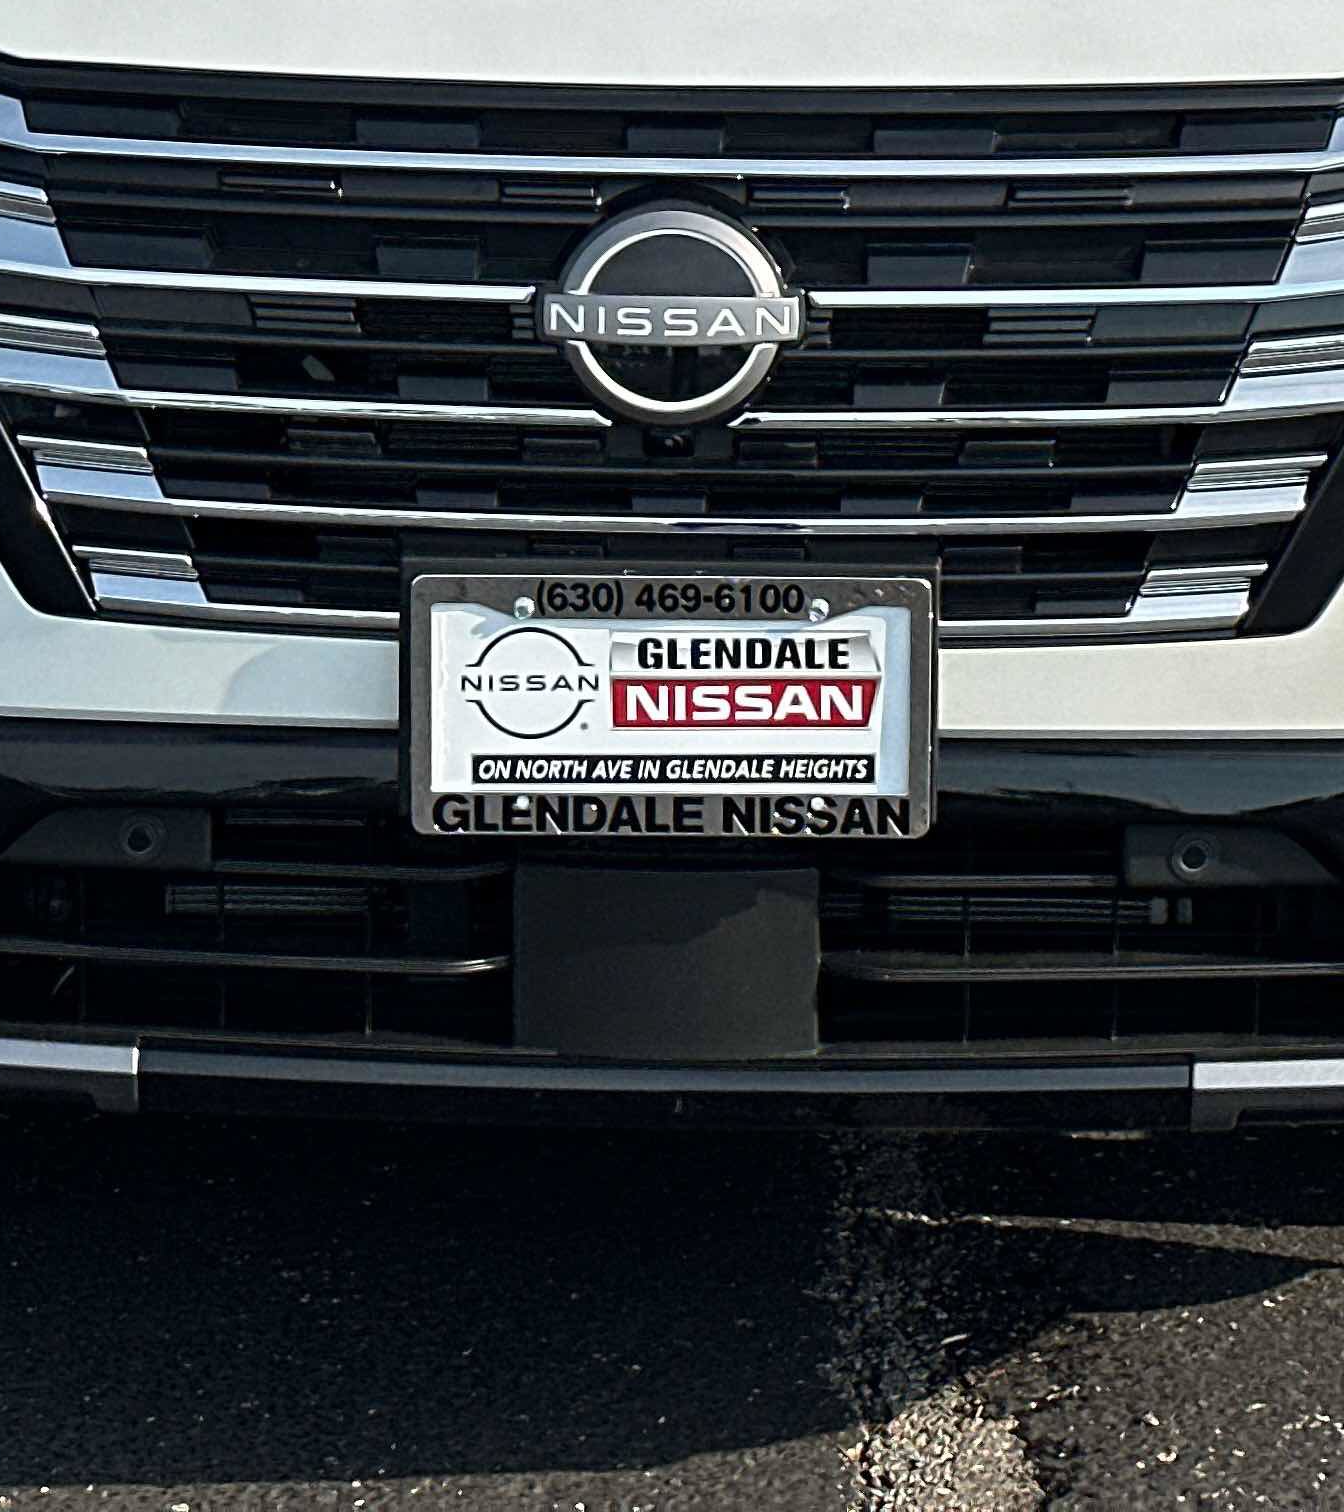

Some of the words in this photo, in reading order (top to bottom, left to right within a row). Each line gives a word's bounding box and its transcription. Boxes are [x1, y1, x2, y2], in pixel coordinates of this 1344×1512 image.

[549, 303, 790, 337] NISSAN
[536, 581, 623, 616] (630)
[635, 583, 805, 613] 469-6100
[637, 638, 850, 670] GLENDALE
[461, 674, 599, 692] NISSAN
[626, 685, 863, 721] NISSAN
[479, 759, 510, 780] ON
[515, 759, 588, 780] NORTH
[592, 759, 632, 780] AVE
[638, 759, 660, 780] IN
[666, 758, 774, 780] GLENDALE
[779, 759, 868, 780] HEIGHTS
[432, 795, 704, 833] GLENDALE
[722, 796, 911, 835] NISSAN
